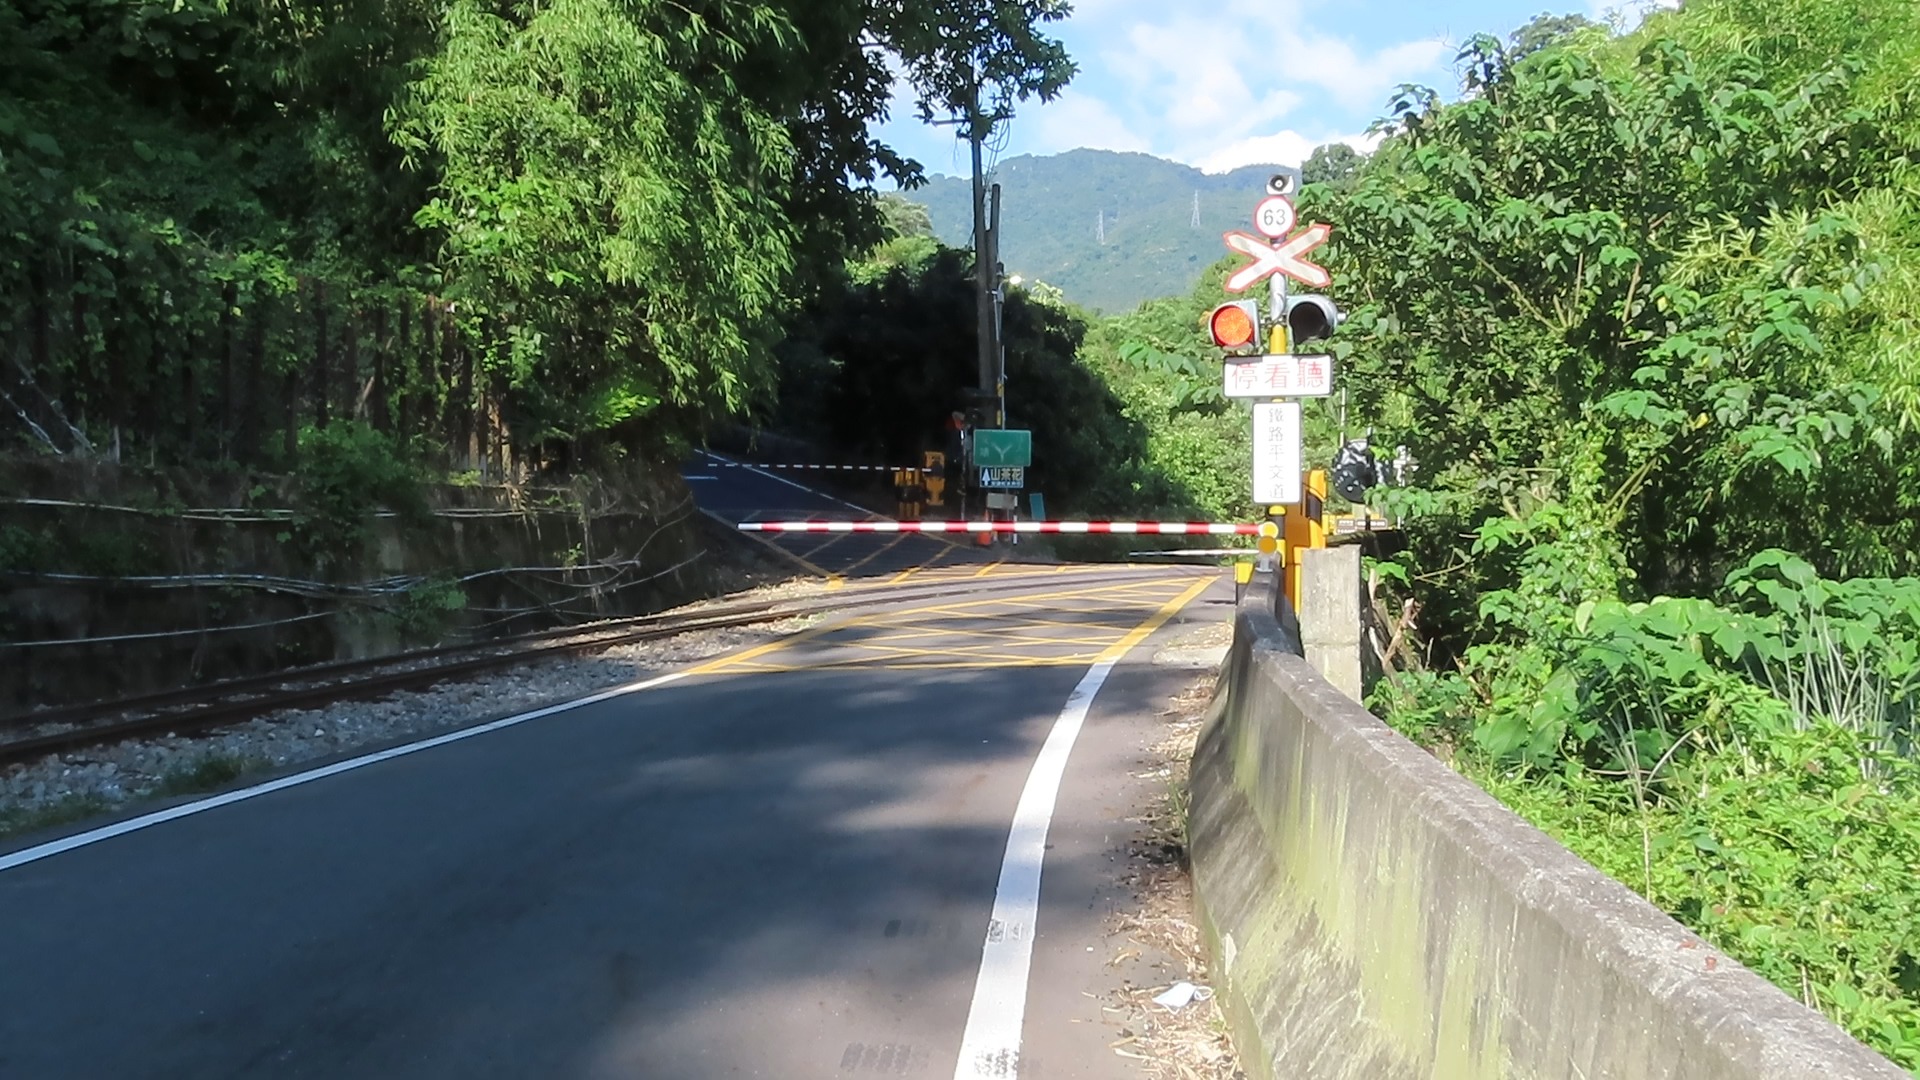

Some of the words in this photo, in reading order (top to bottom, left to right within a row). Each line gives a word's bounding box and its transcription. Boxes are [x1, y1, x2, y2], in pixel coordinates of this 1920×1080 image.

[1263, 208, 1286, 226] 63
[1231, 360, 1324, 390] 停看聽
[1268, 407, 1285, 499] 鐵路平交道
[990, 467, 1022, 481] 山茶花
